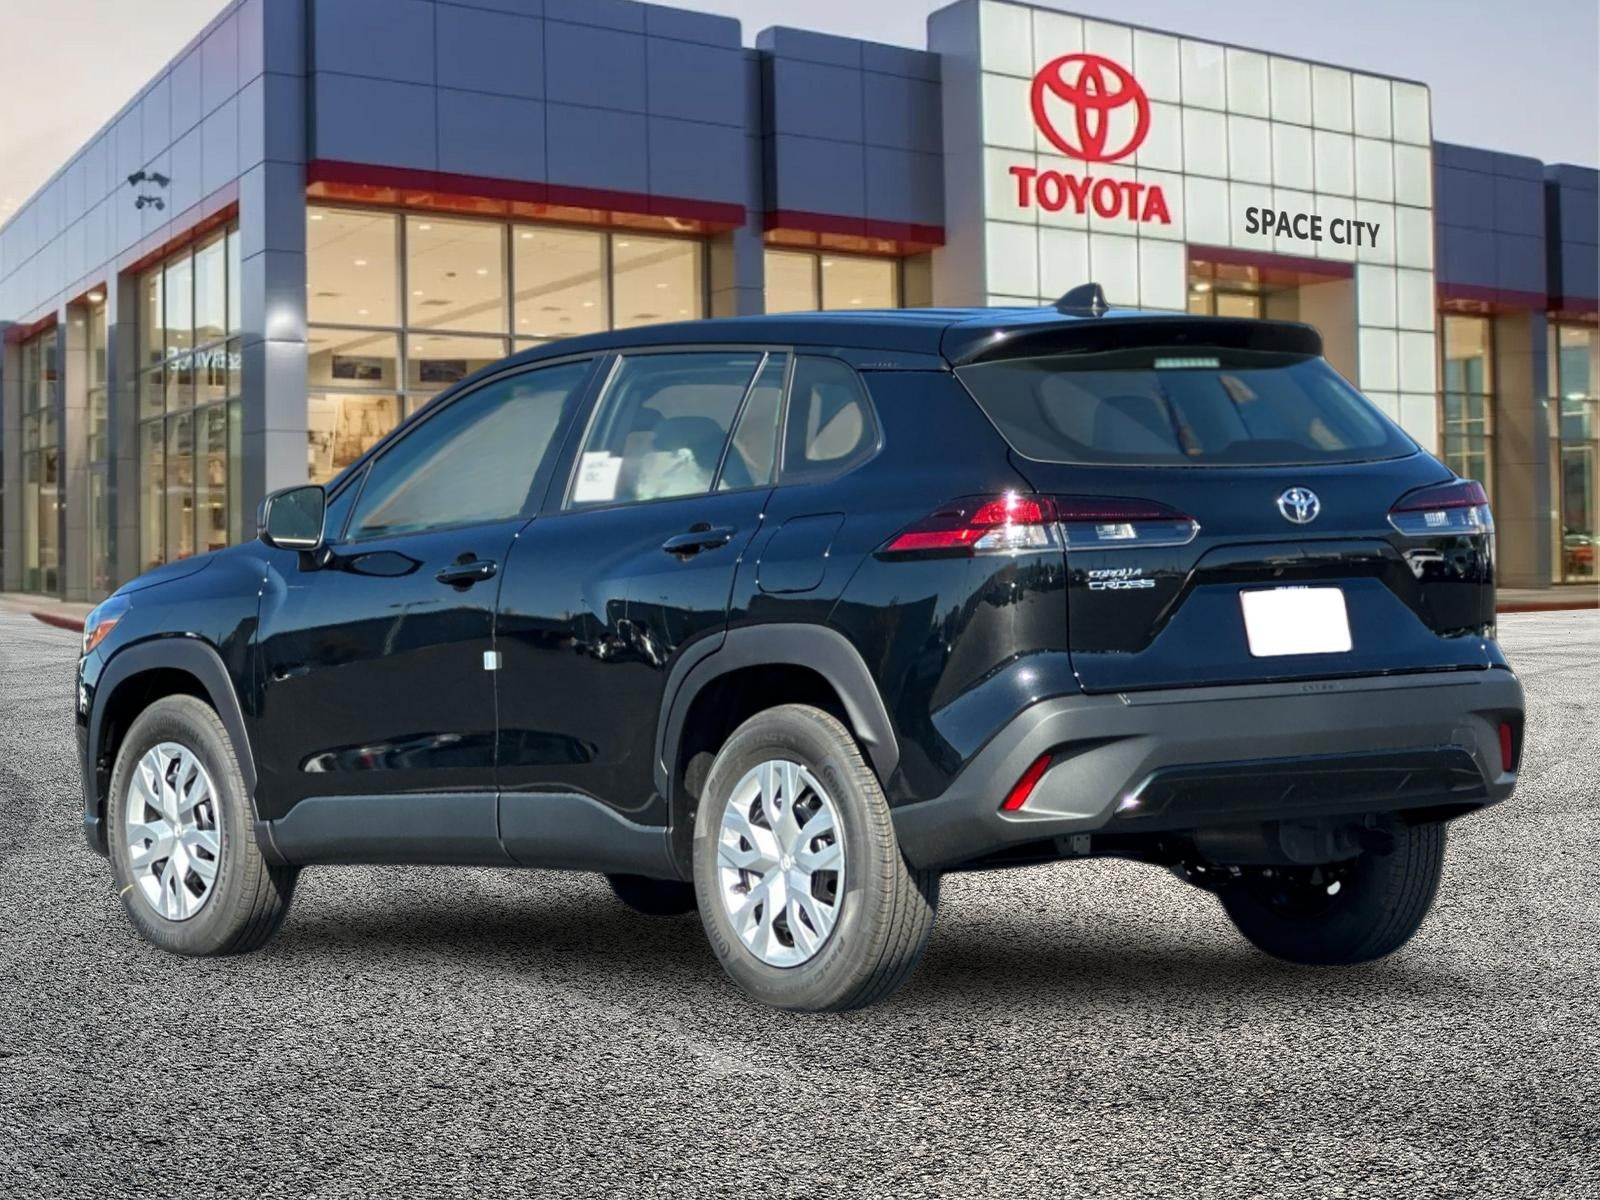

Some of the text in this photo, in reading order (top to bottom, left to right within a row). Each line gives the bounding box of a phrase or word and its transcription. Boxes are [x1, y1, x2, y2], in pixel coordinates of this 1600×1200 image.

[1009, 166, 1171, 224] TOYOTA
[1245, 206, 1381, 248] SPACE CITY
[1088, 579, 1156, 590] CROSS
